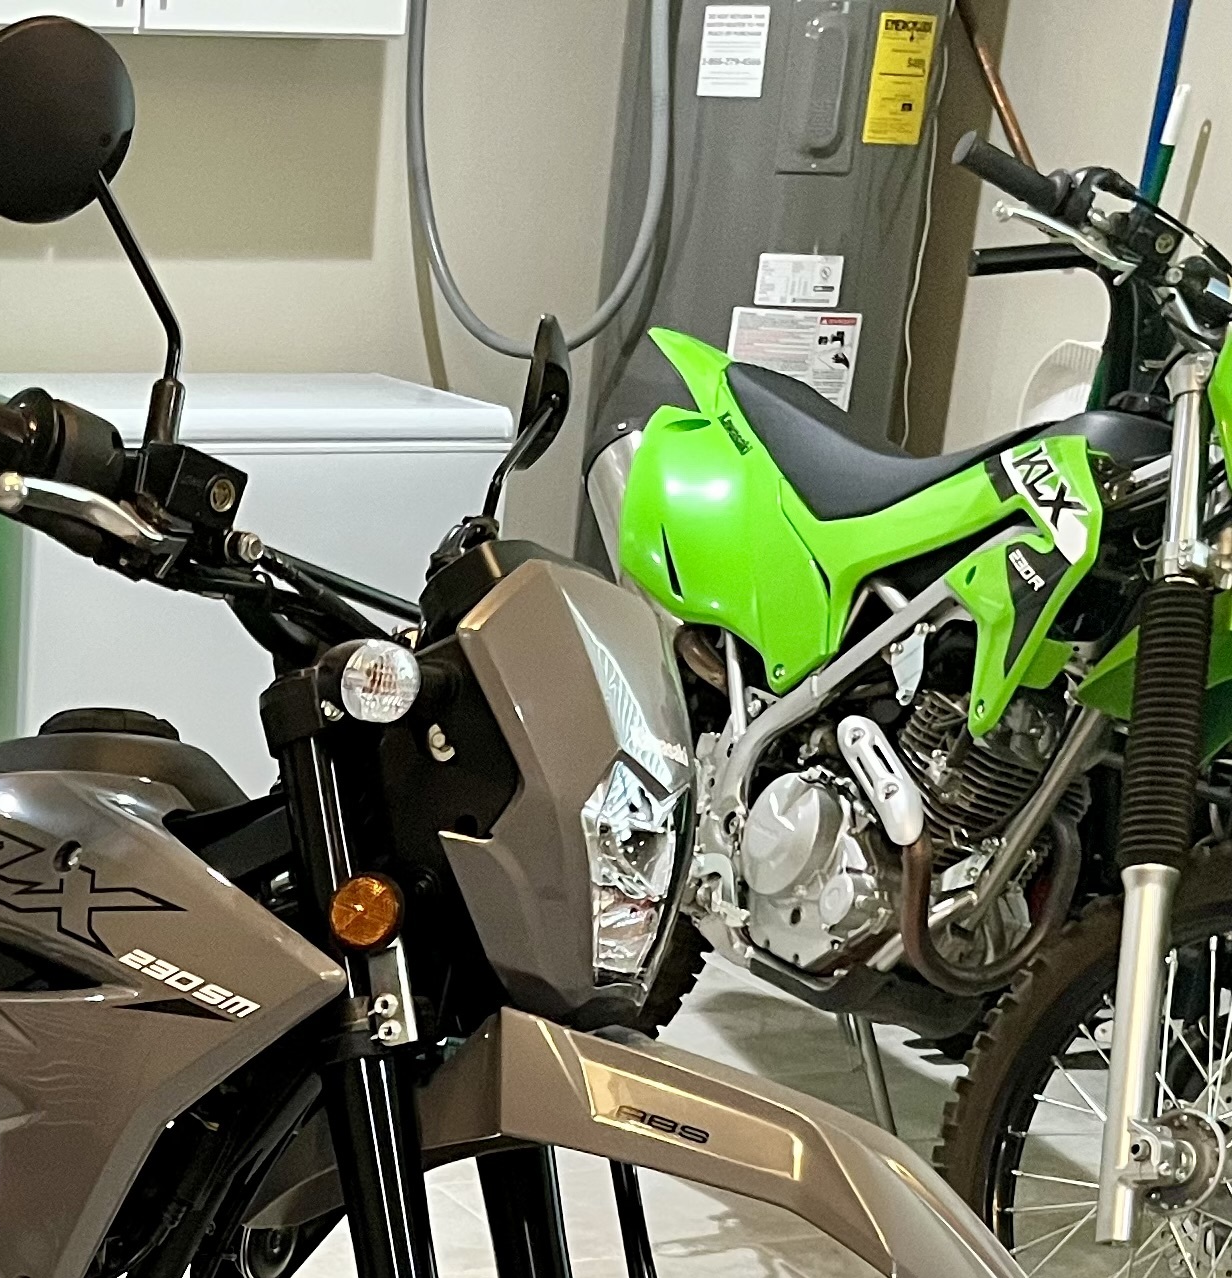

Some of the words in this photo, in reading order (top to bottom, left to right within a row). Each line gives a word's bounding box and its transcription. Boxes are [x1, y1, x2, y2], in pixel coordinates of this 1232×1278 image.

[1012, 446, 1089, 532] KLX
[1008, 548, 1046, 592] 230R
[616, 1104, 710, 1144] ABS
